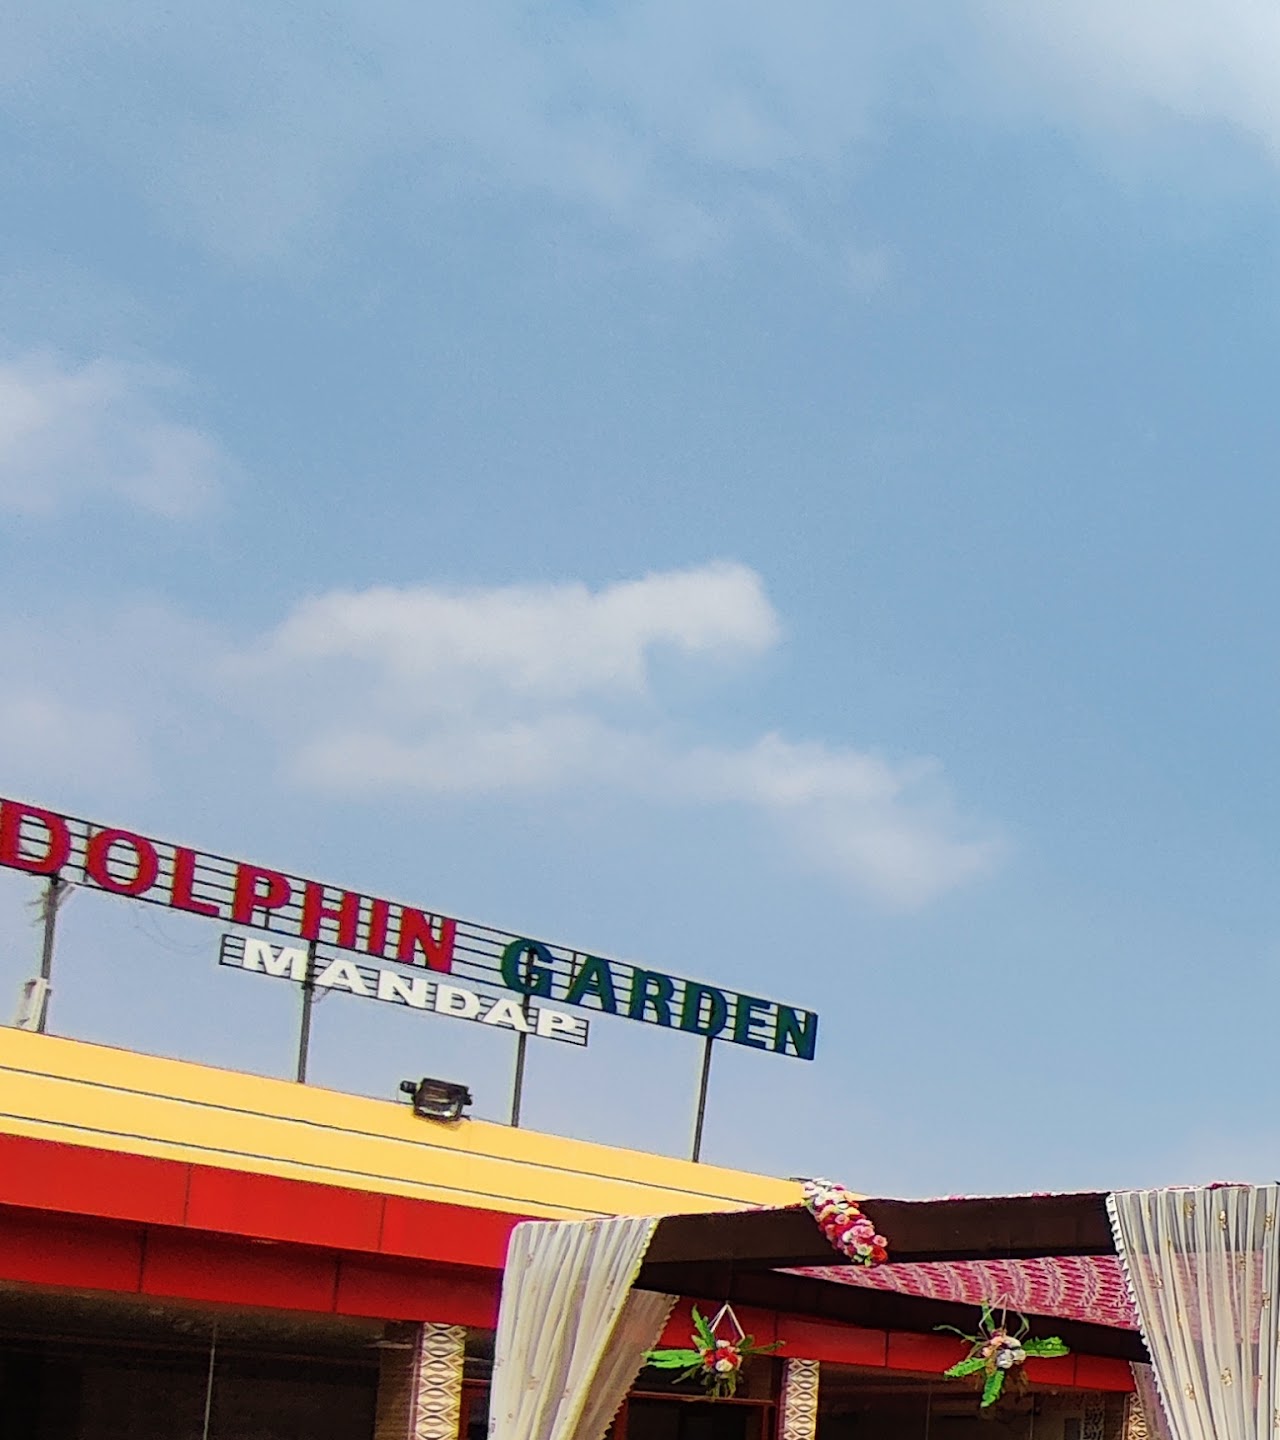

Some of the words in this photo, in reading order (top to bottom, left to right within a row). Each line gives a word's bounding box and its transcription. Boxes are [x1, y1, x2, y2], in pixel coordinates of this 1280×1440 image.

[0, 799, 456, 974] DOLPHIN
[501, 938, 818, 1060] GARDEN
[242, 937, 577, 1037] MANDAP
